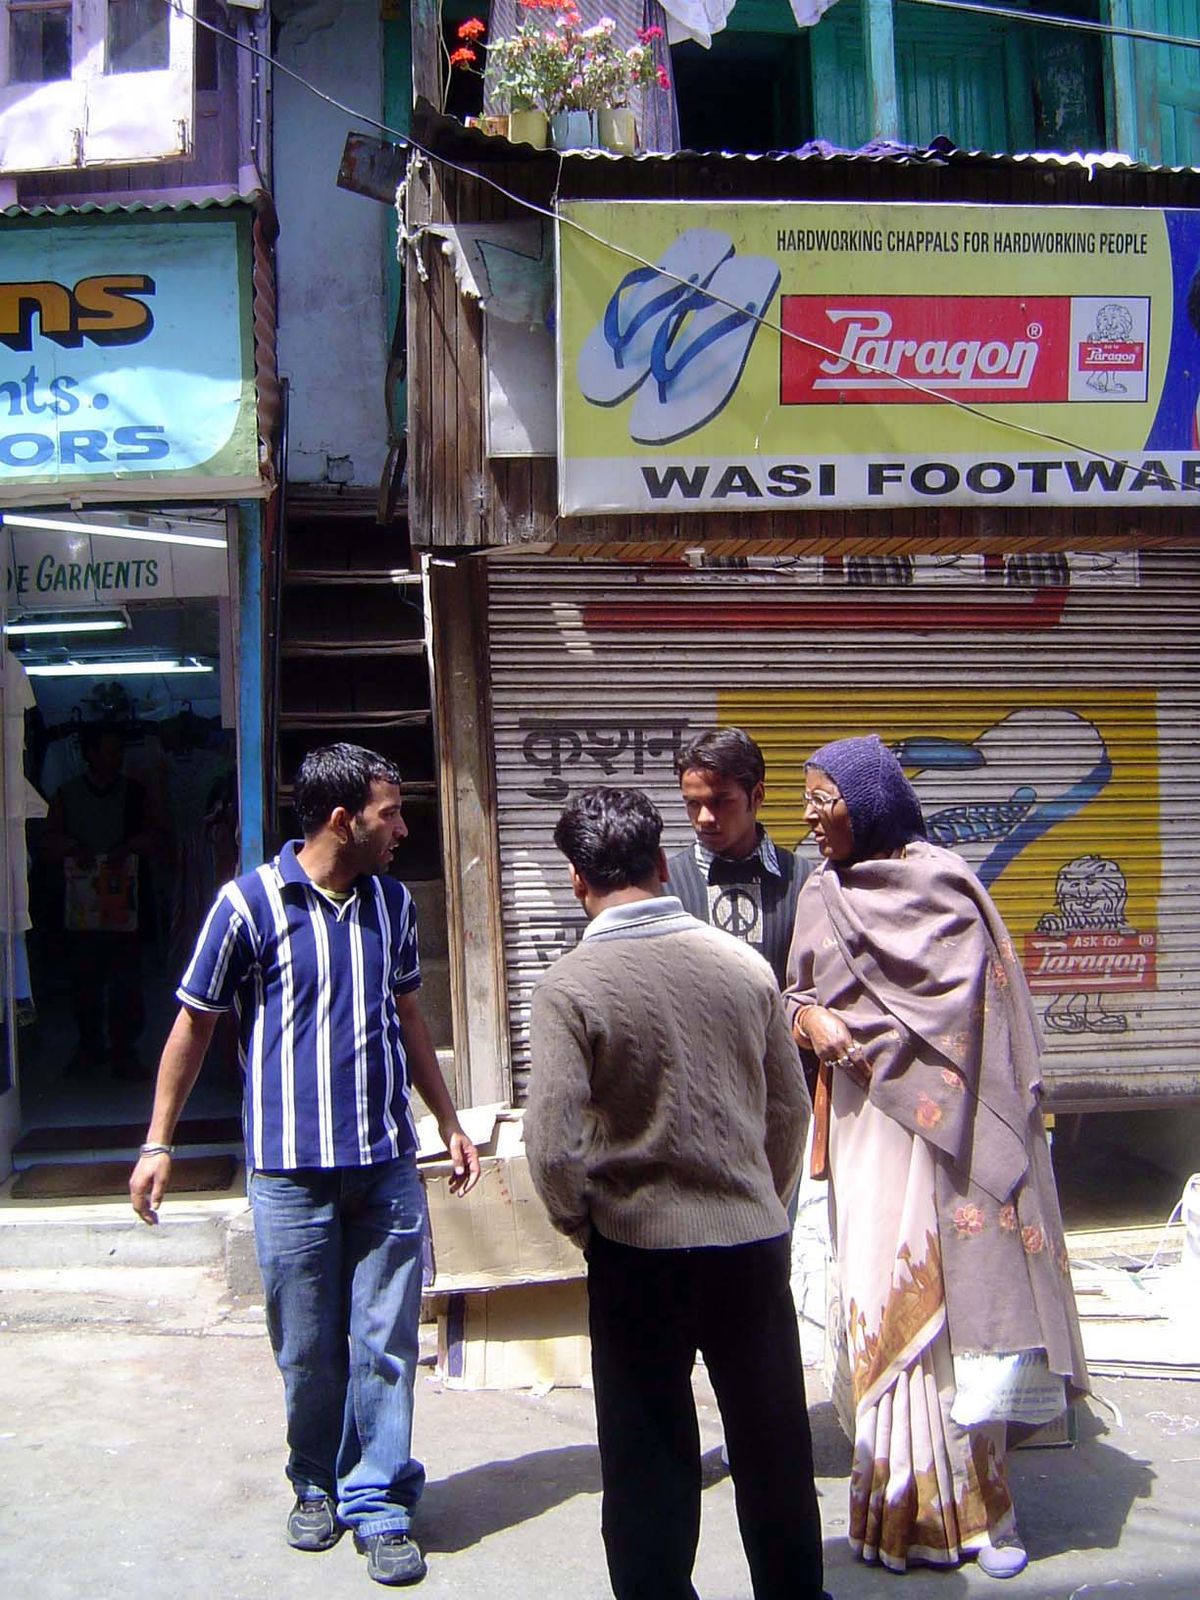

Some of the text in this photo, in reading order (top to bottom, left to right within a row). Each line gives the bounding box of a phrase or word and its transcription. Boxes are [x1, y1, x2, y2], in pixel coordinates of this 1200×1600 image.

[777, 230, 1148, 254] HARDWORKING CHAPPALS FOR HARDWORKING PEOPLE
[812, 309, 1040, 390] Paragon
[1085, 347, 1136, 364] Paragon
[640, 464, 836, 499] WASI
[36, 554, 158, 593] GARMENTS
[1029, 941, 1147, 987] Paragon
